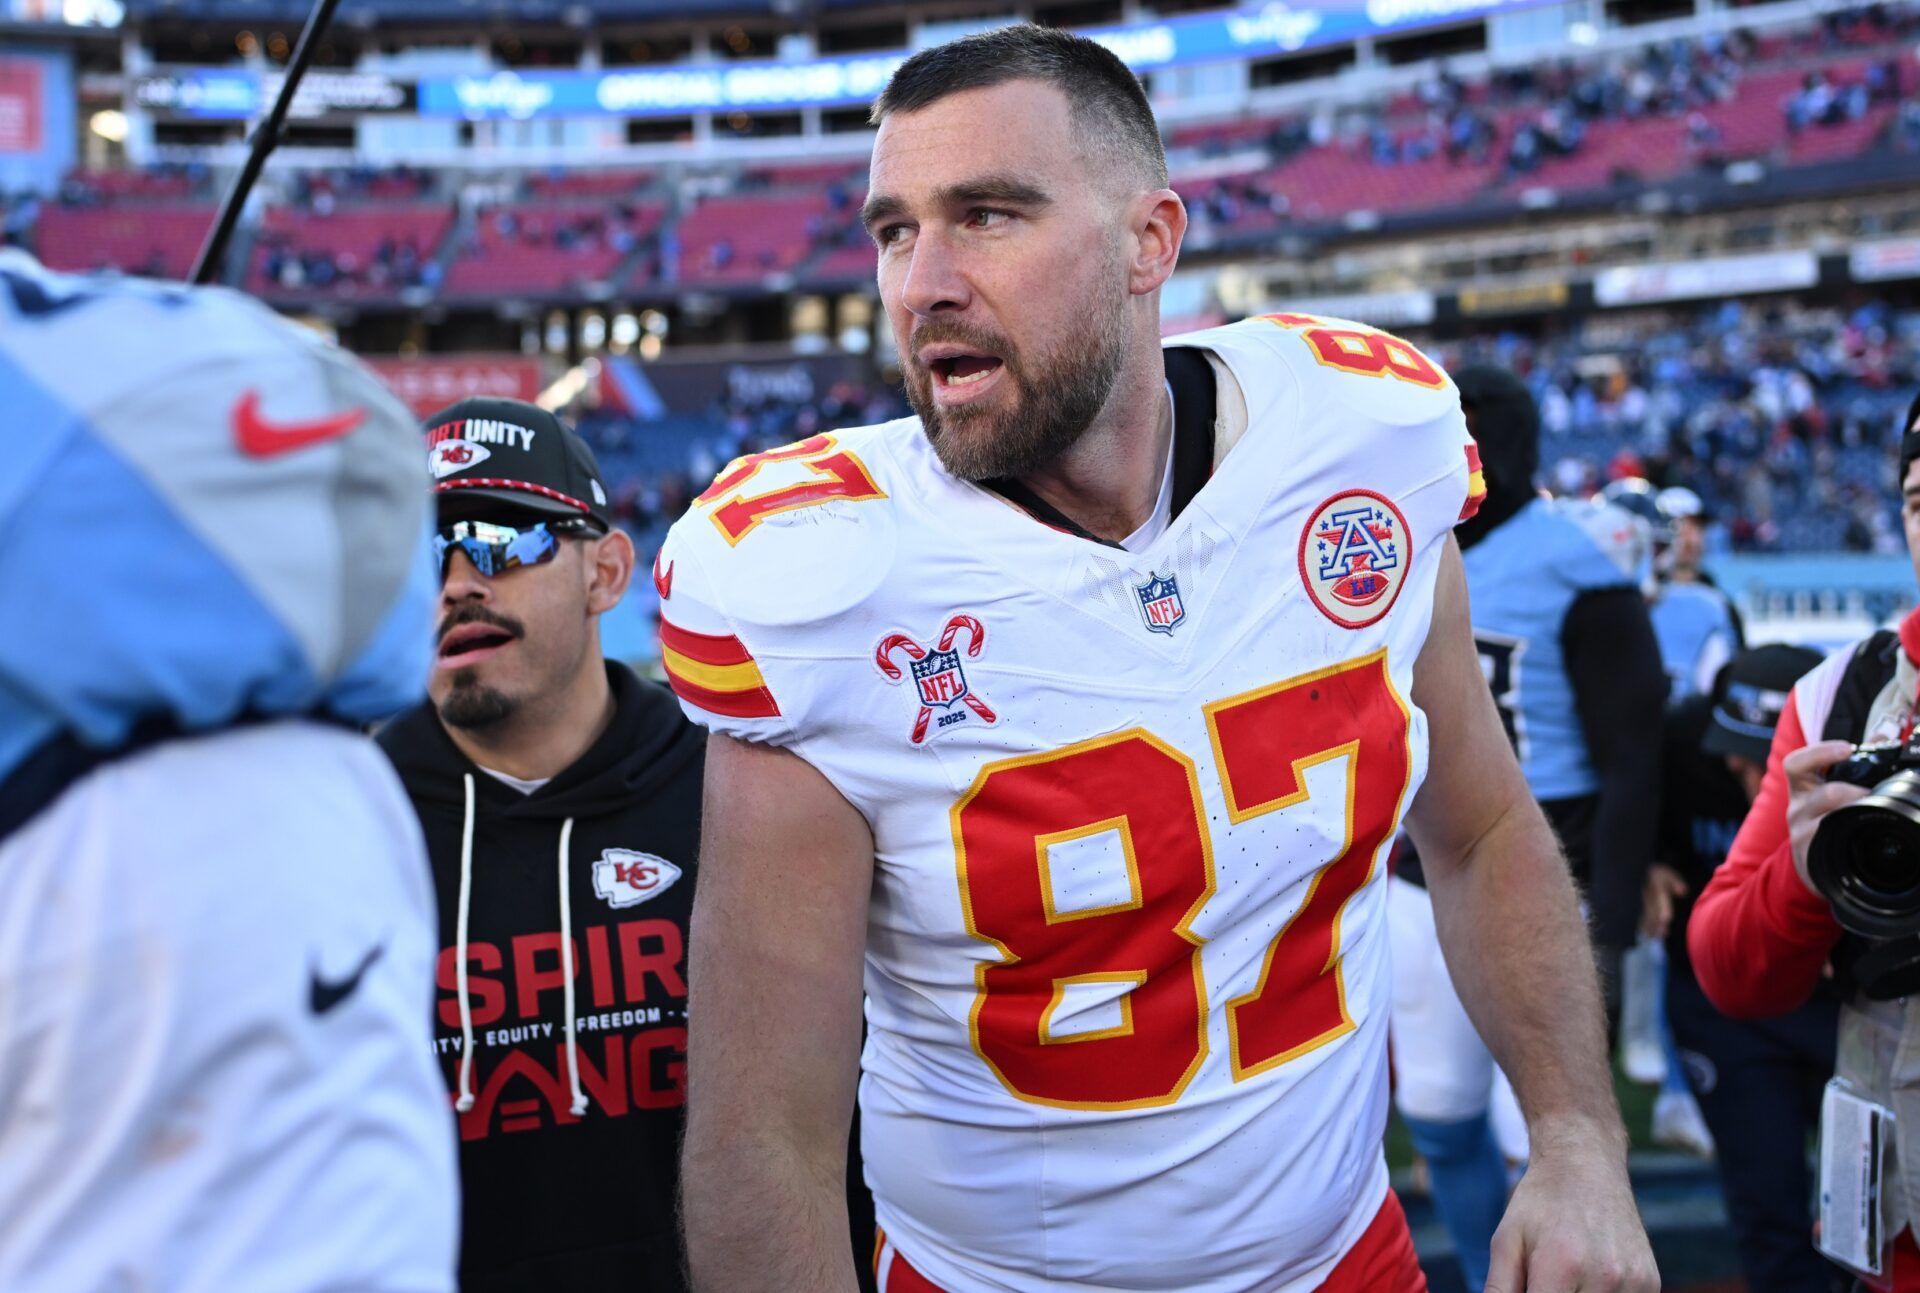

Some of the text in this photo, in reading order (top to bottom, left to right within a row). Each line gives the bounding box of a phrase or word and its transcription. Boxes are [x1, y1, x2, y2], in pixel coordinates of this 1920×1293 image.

[1350, 578, 1375, 596] LH
[1147, 597, 1181, 624] NFL
[920, 671, 963, 701] NFL
[937, 710, 967, 727] 2025
[949, 646, 1411, 1112] 87
[486, 1022, 553, 1046] EQUITY
[576, 1007, 660, 1033] FREEDOM
